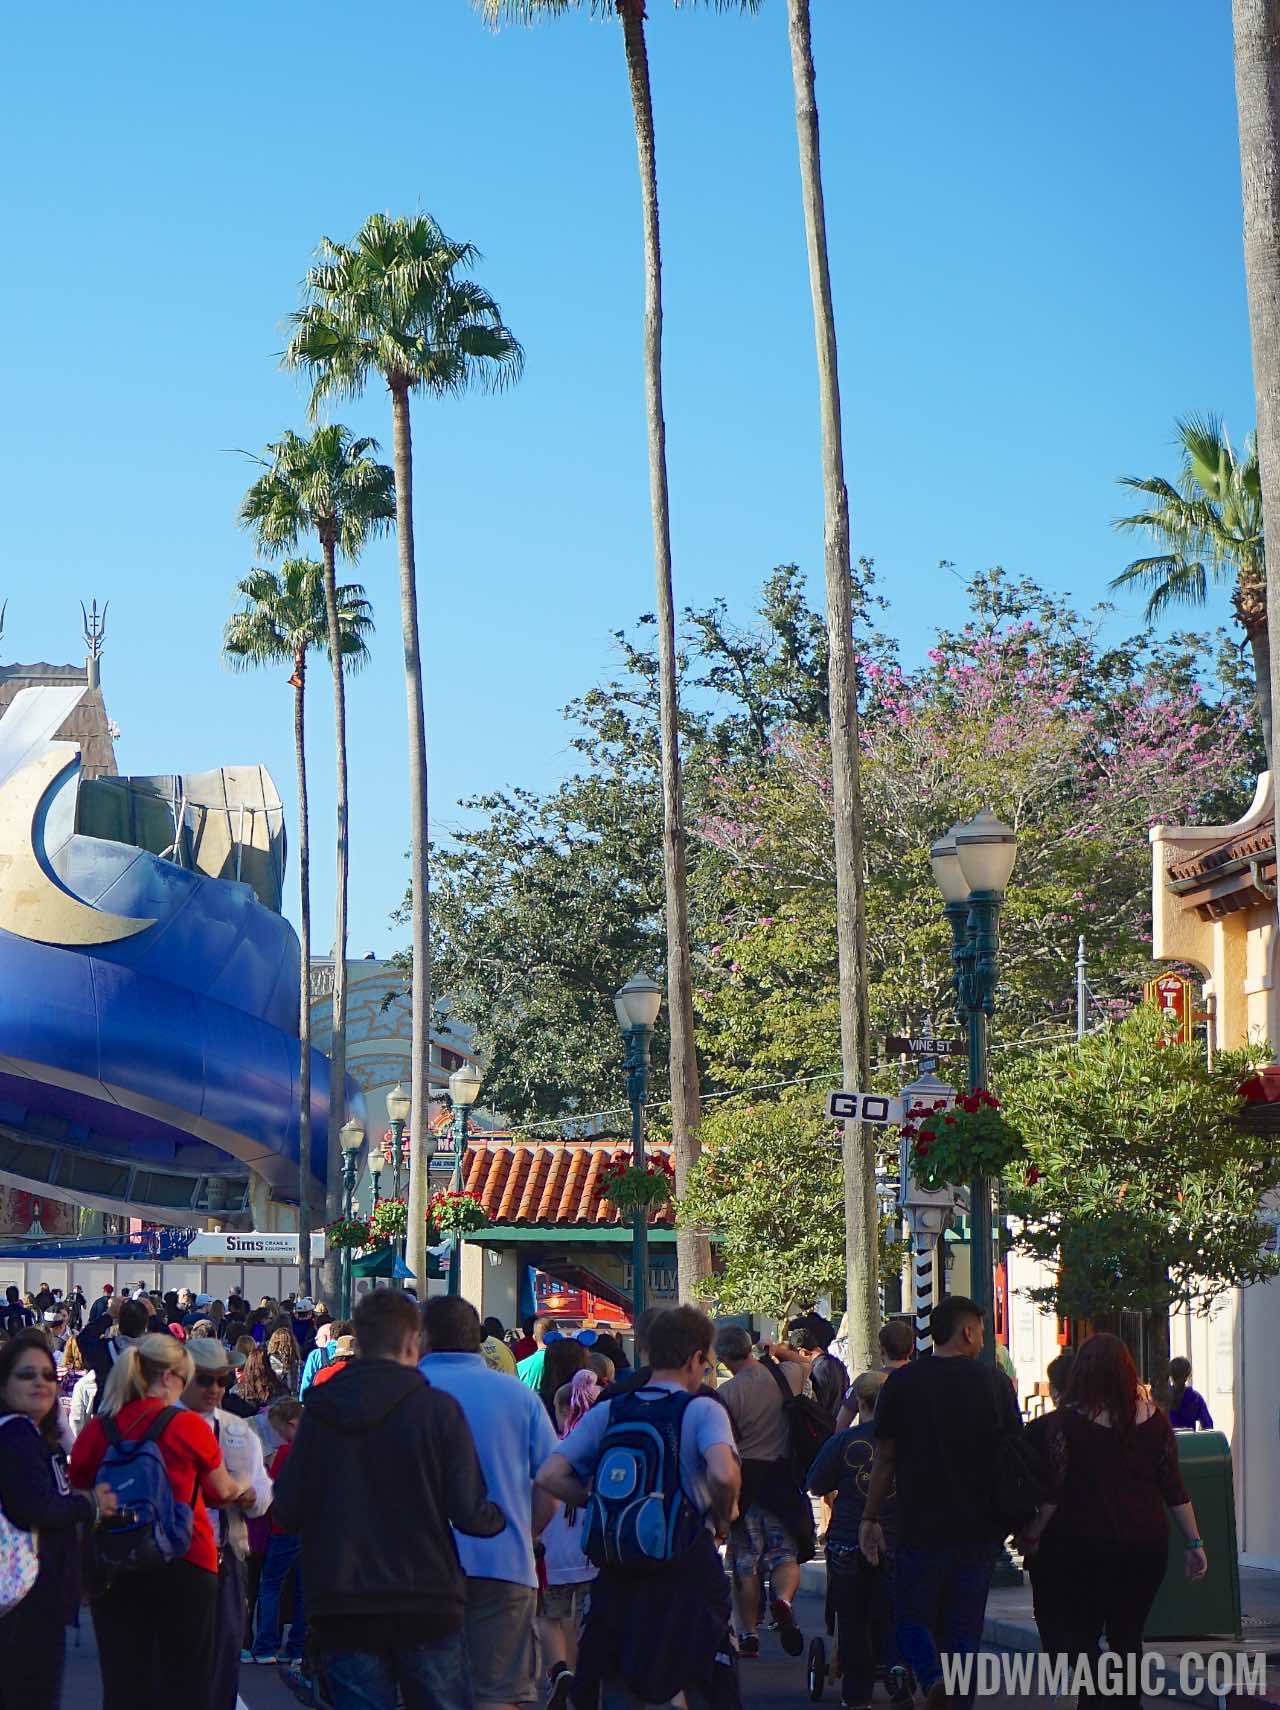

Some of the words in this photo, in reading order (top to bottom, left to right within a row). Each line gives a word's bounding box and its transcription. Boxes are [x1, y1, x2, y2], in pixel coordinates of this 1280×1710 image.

[908, 1039, 934, 1052] VINE
[936, 1040, 953, 1052] ST.
[830, 1093, 889, 1121] GO
[226, 1235, 264, 1251] Sims
